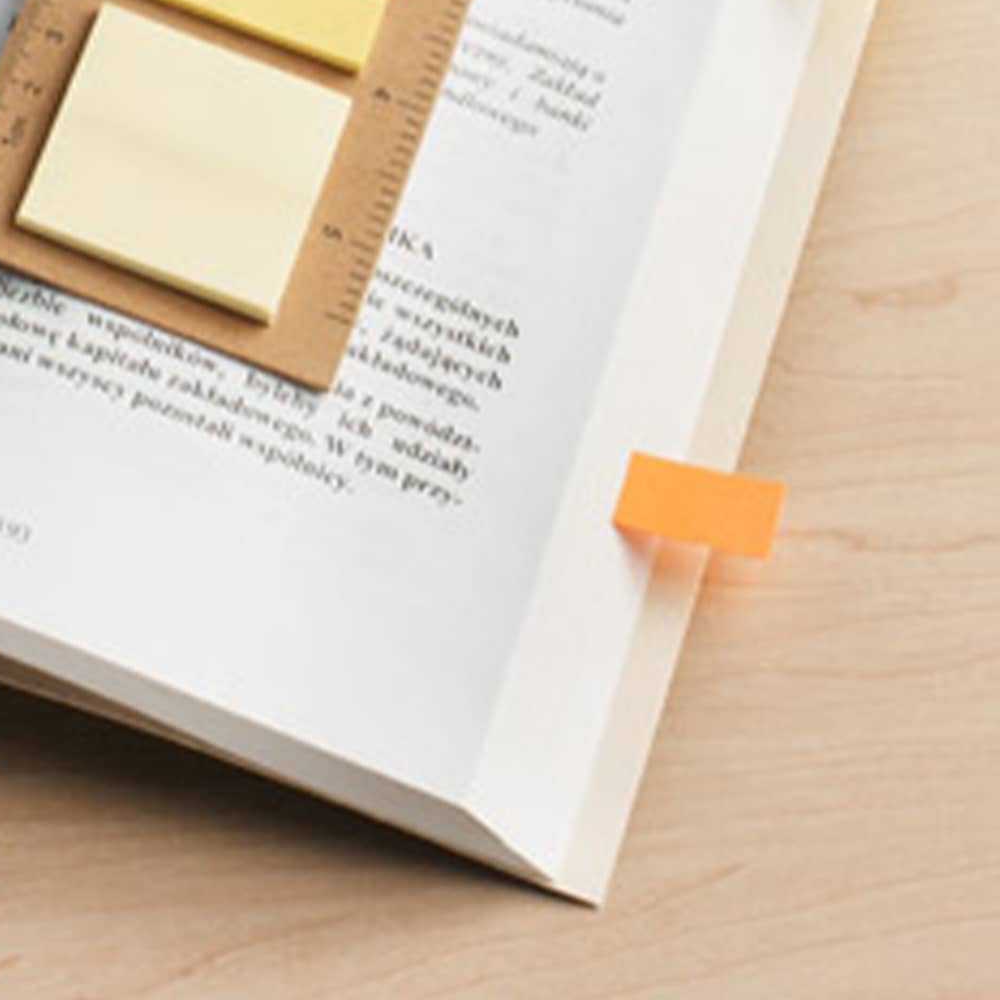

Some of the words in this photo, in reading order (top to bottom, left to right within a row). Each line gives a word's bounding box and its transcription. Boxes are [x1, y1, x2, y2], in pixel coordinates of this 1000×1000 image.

[321, 223, 343, 242] 5
[379, 327, 504, 393] żądających
[394, 304, 513, 366] wszystkich
[35, 353, 127, 404] wszyscy
[129, 387, 234, 443] pozostali
[238, 434, 355, 496] wspólnicy.
[66, 330, 163, 383] kapitału
[166, 374, 318, 448] zakładowego.
[325, 434, 348, 459] W
[354, 448, 400, 482] tym
[86, 310, 227, 380] wspólników,
[337, 411, 374, 440] ich
[391, 435, 471, 484] udziały
